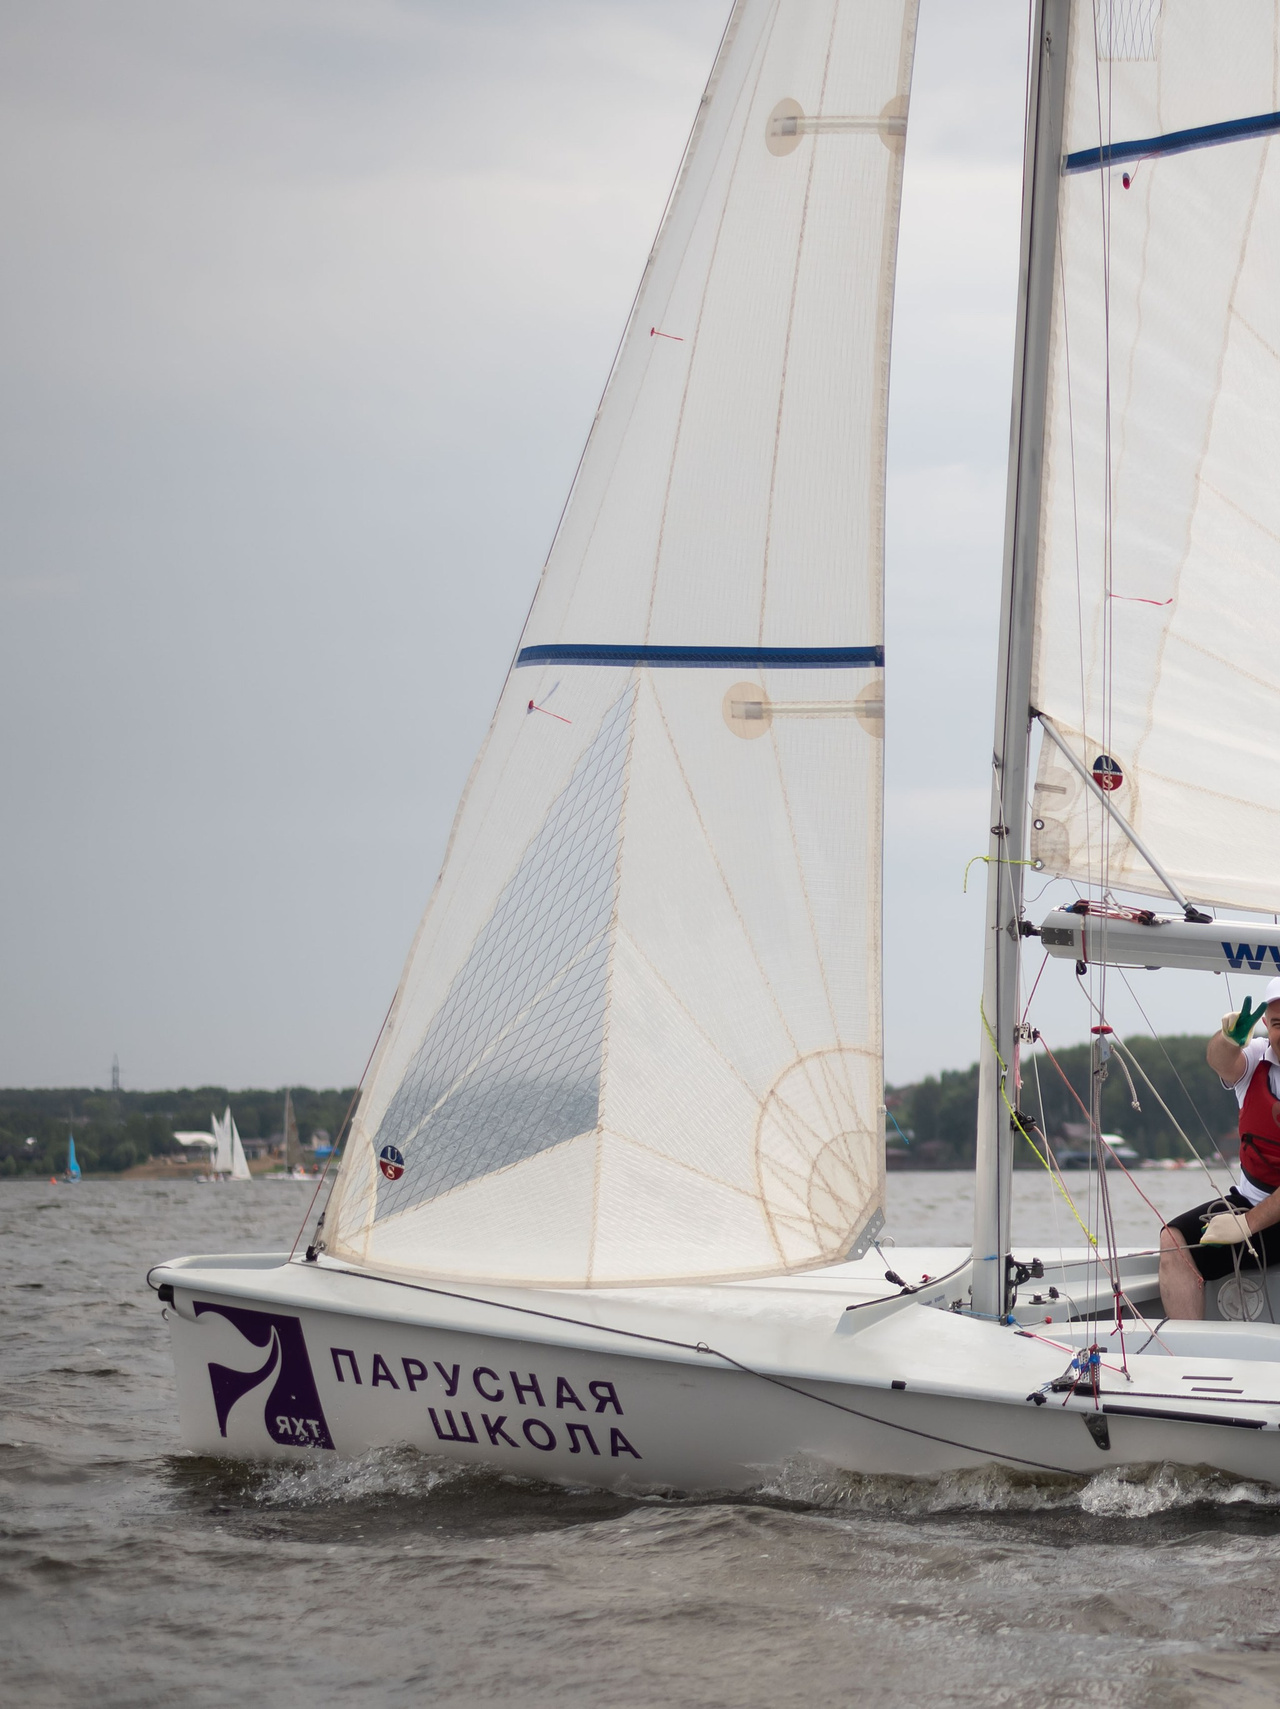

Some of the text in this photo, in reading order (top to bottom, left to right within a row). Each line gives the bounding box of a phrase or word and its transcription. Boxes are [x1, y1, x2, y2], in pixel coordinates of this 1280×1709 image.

[387, 1147, 399, 1162] U
[386, 1165, 395, 1179] S
[330, 1347, 625, 1416] ПАРУСНАЯ
[276, 1415, 320, 1438] ЯХТ
[427, 1407, 643, 1460] ШКОЛА
